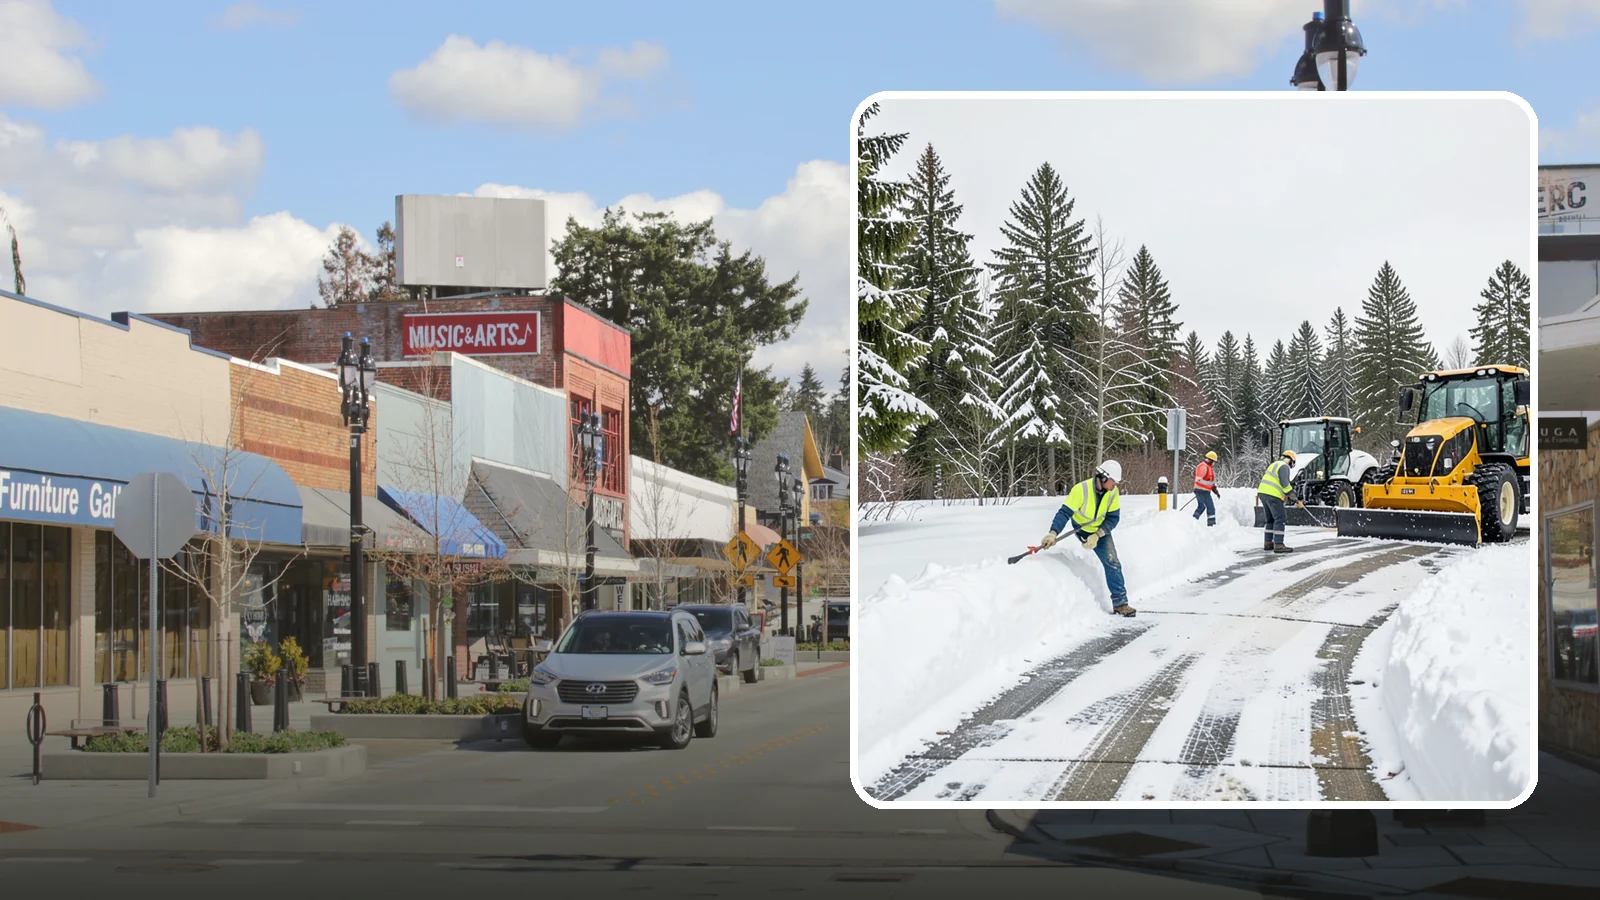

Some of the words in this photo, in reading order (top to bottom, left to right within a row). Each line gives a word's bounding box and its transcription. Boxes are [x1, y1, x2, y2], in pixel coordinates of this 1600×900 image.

[408, 323, 519, 349] MUSIC&ARTS
[0, 471, 79, 515] Furniture
[89, 482, 122, 519] Gal
[453, 562, 479, 574] SUSHI
